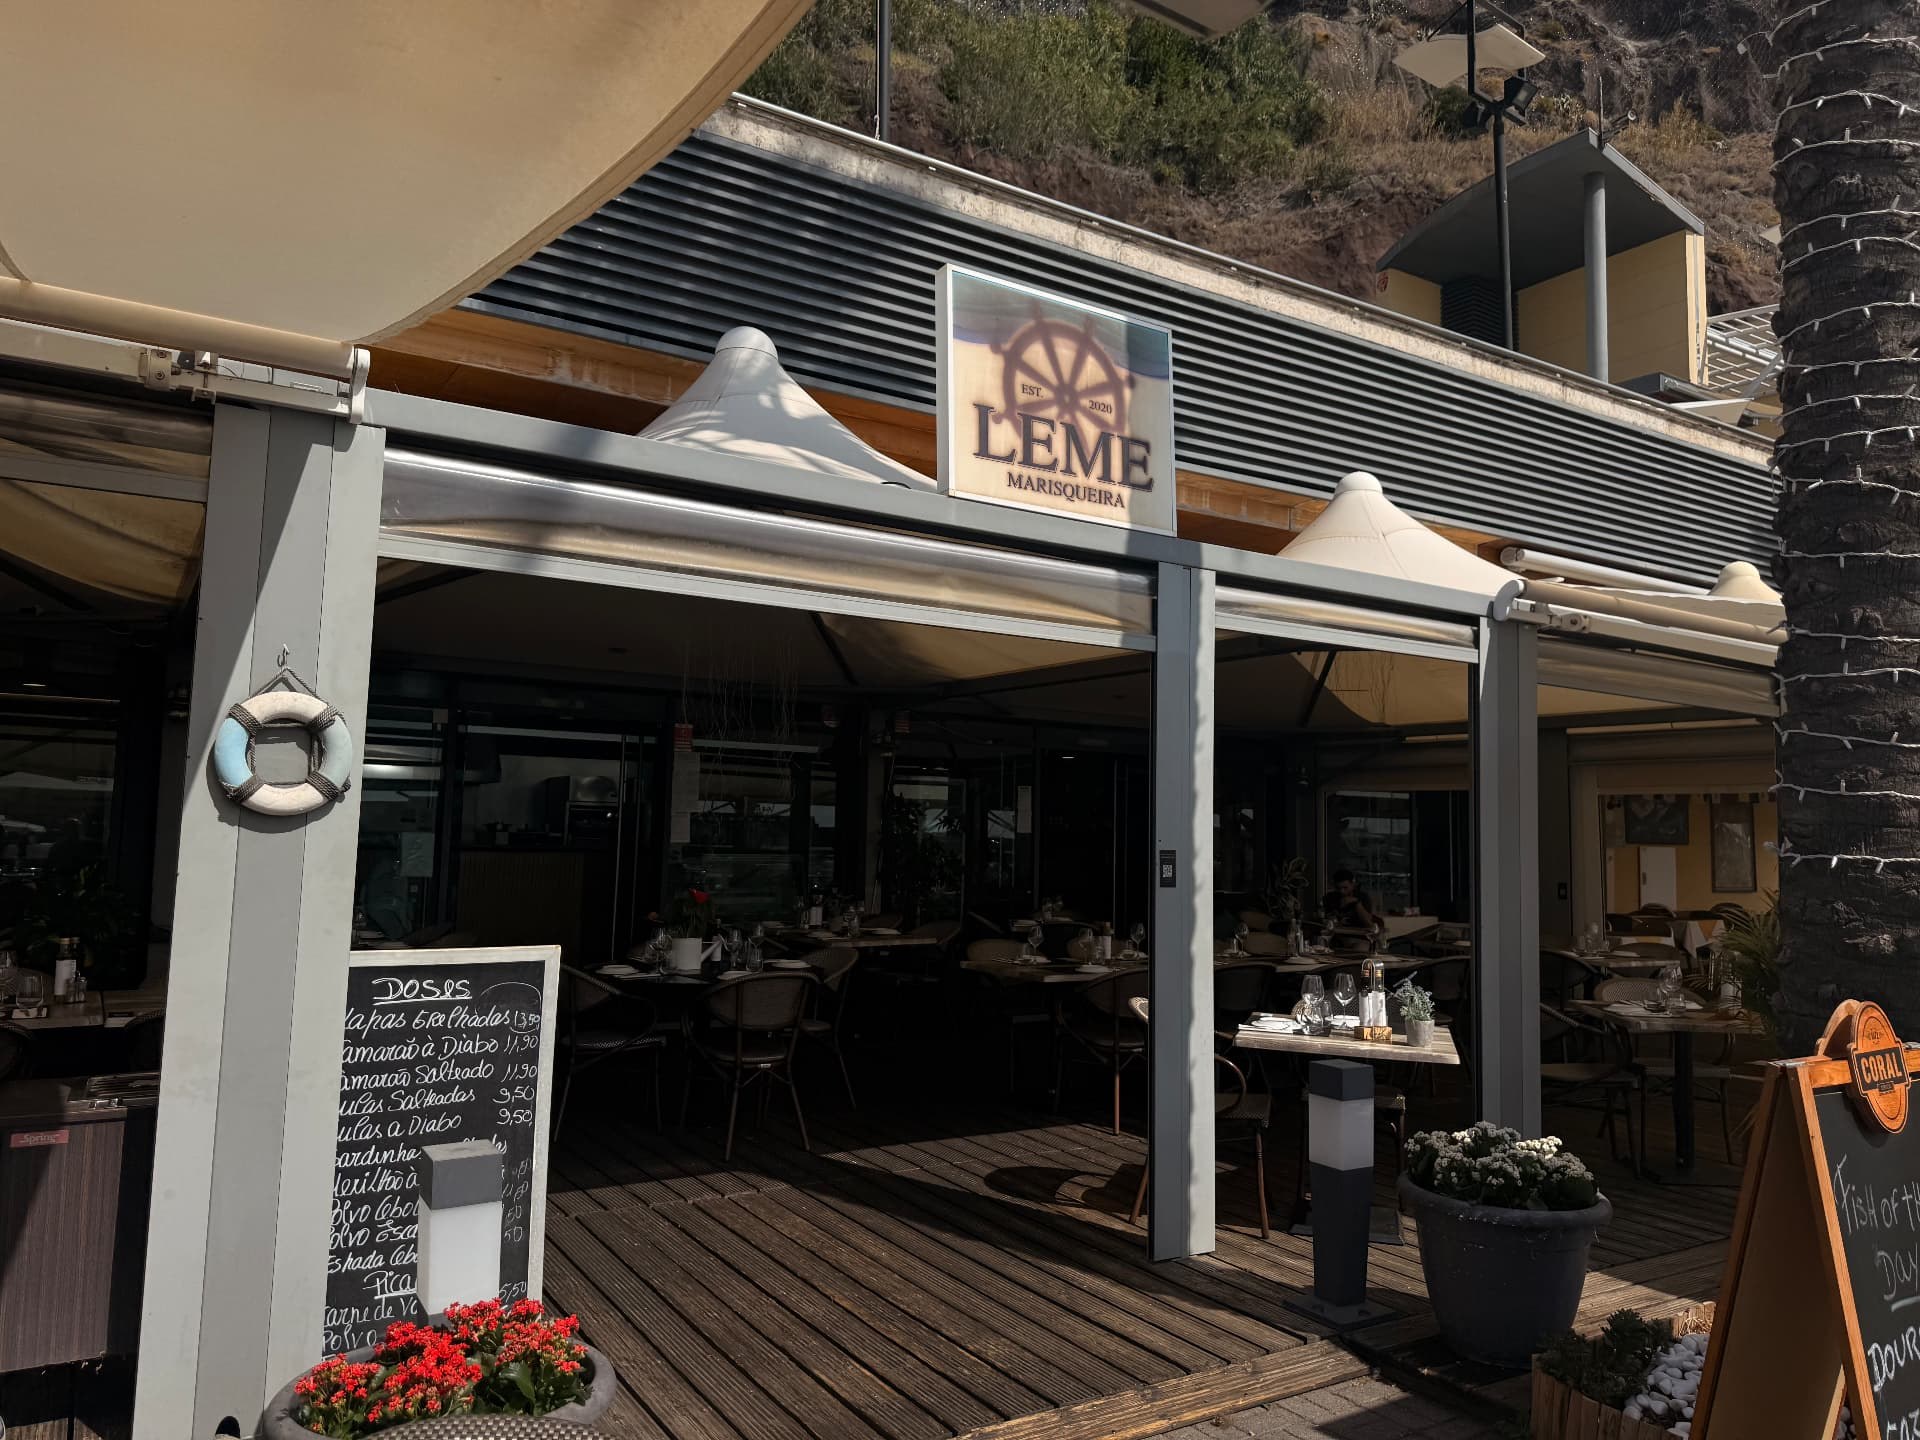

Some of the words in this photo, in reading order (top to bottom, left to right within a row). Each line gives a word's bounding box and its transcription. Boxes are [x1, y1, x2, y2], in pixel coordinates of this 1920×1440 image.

[1021, 383, 1044, 398] EST.
[1088, 399, 1113, 415] 2020
[972, 402, 1155, 493] LEME
[1006, 472, 1126, 509] MARISQUEIRA
[342, 1036, 420, 1064] amarão
[438, 1032, 499, 1061] Diabo
[503, 1034, 540, 1056] 11,90
[340, 1067, 412, 1091] amarão
[415, 1058, 495, 1084] Salteado
[500, 1063, 538, 1083] 11,90
[1860, 1052, 1903, 1084] CORAL
[339, 1091, 384, 1116] ulas
[387, 1084, 477, 1112] Salteadas
[492, 1084, 536, 1104] 9,50
[337, 1115, 383, 1142] ulas
[408, 1113, 463, 1136] Diabo
[329, 1222, 370, 1250] olvo
[373, 1294, 396, 1321] de
